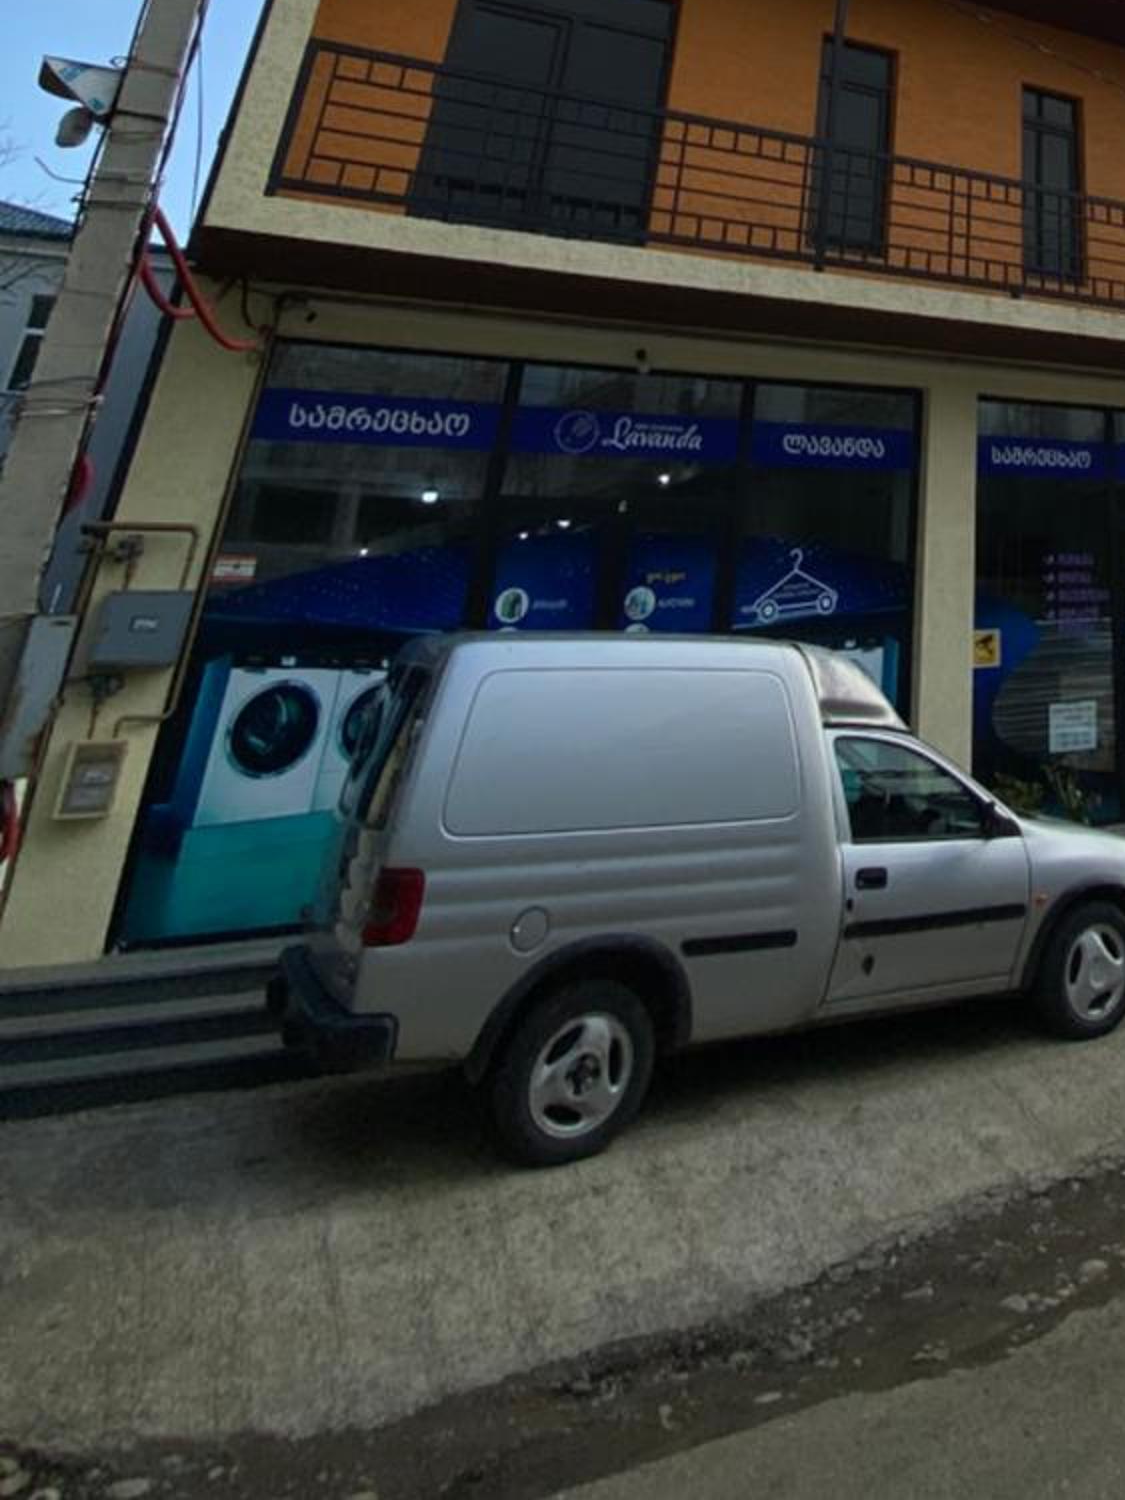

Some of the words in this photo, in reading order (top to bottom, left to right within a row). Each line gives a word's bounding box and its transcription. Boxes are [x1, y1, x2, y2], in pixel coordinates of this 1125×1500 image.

[288, 402, 471, 437] სამრეცხაო
[601, 416, 704, 451] Lavanda
[782, 433, 886, 459] ლავანდა
[990, 445, 1092, 469] სამრეცხაო
